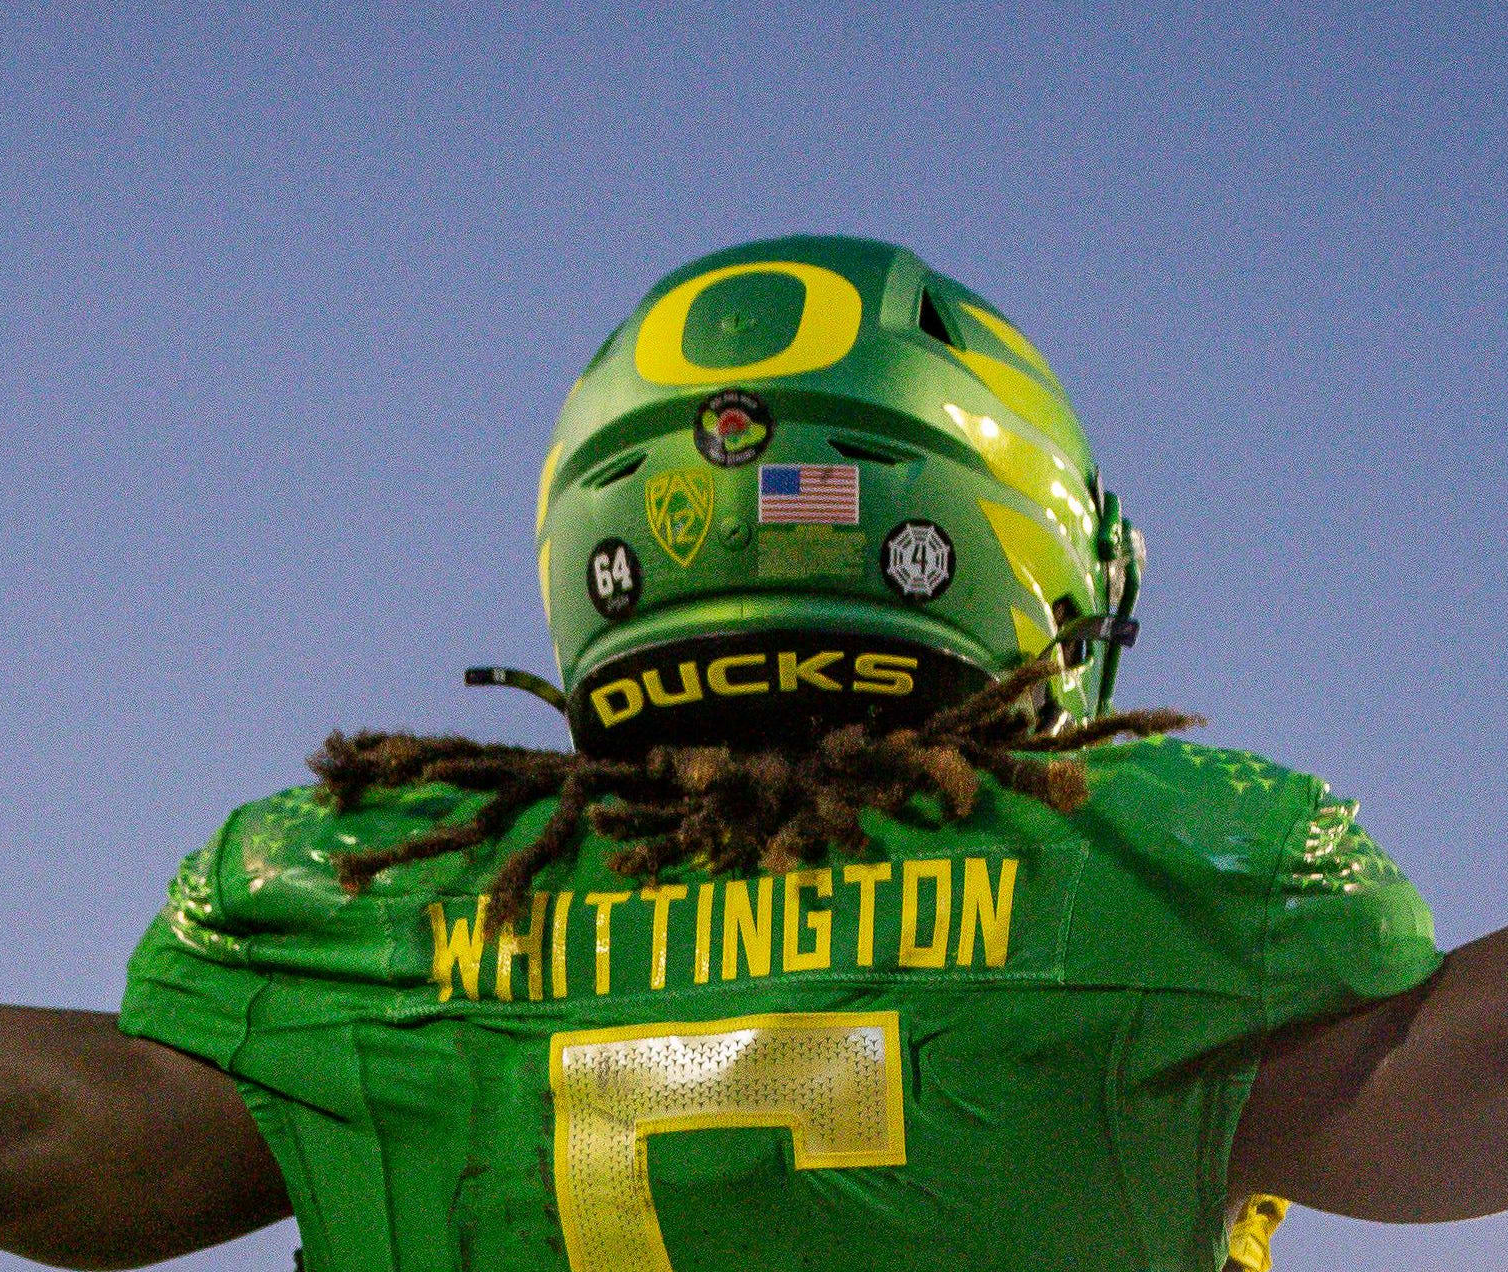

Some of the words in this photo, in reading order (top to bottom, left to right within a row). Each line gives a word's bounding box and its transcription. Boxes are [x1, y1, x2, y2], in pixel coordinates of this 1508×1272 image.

[650, 471, 708, 529] PAC
[666, 509, 696, 545] 12
[594, 546, 634, 598] 64
[911, 543, 928, 575] 4
[590, 652, 918, 728] DUCKS
[428, 858, 1019, 1001] WHITTINGTON
